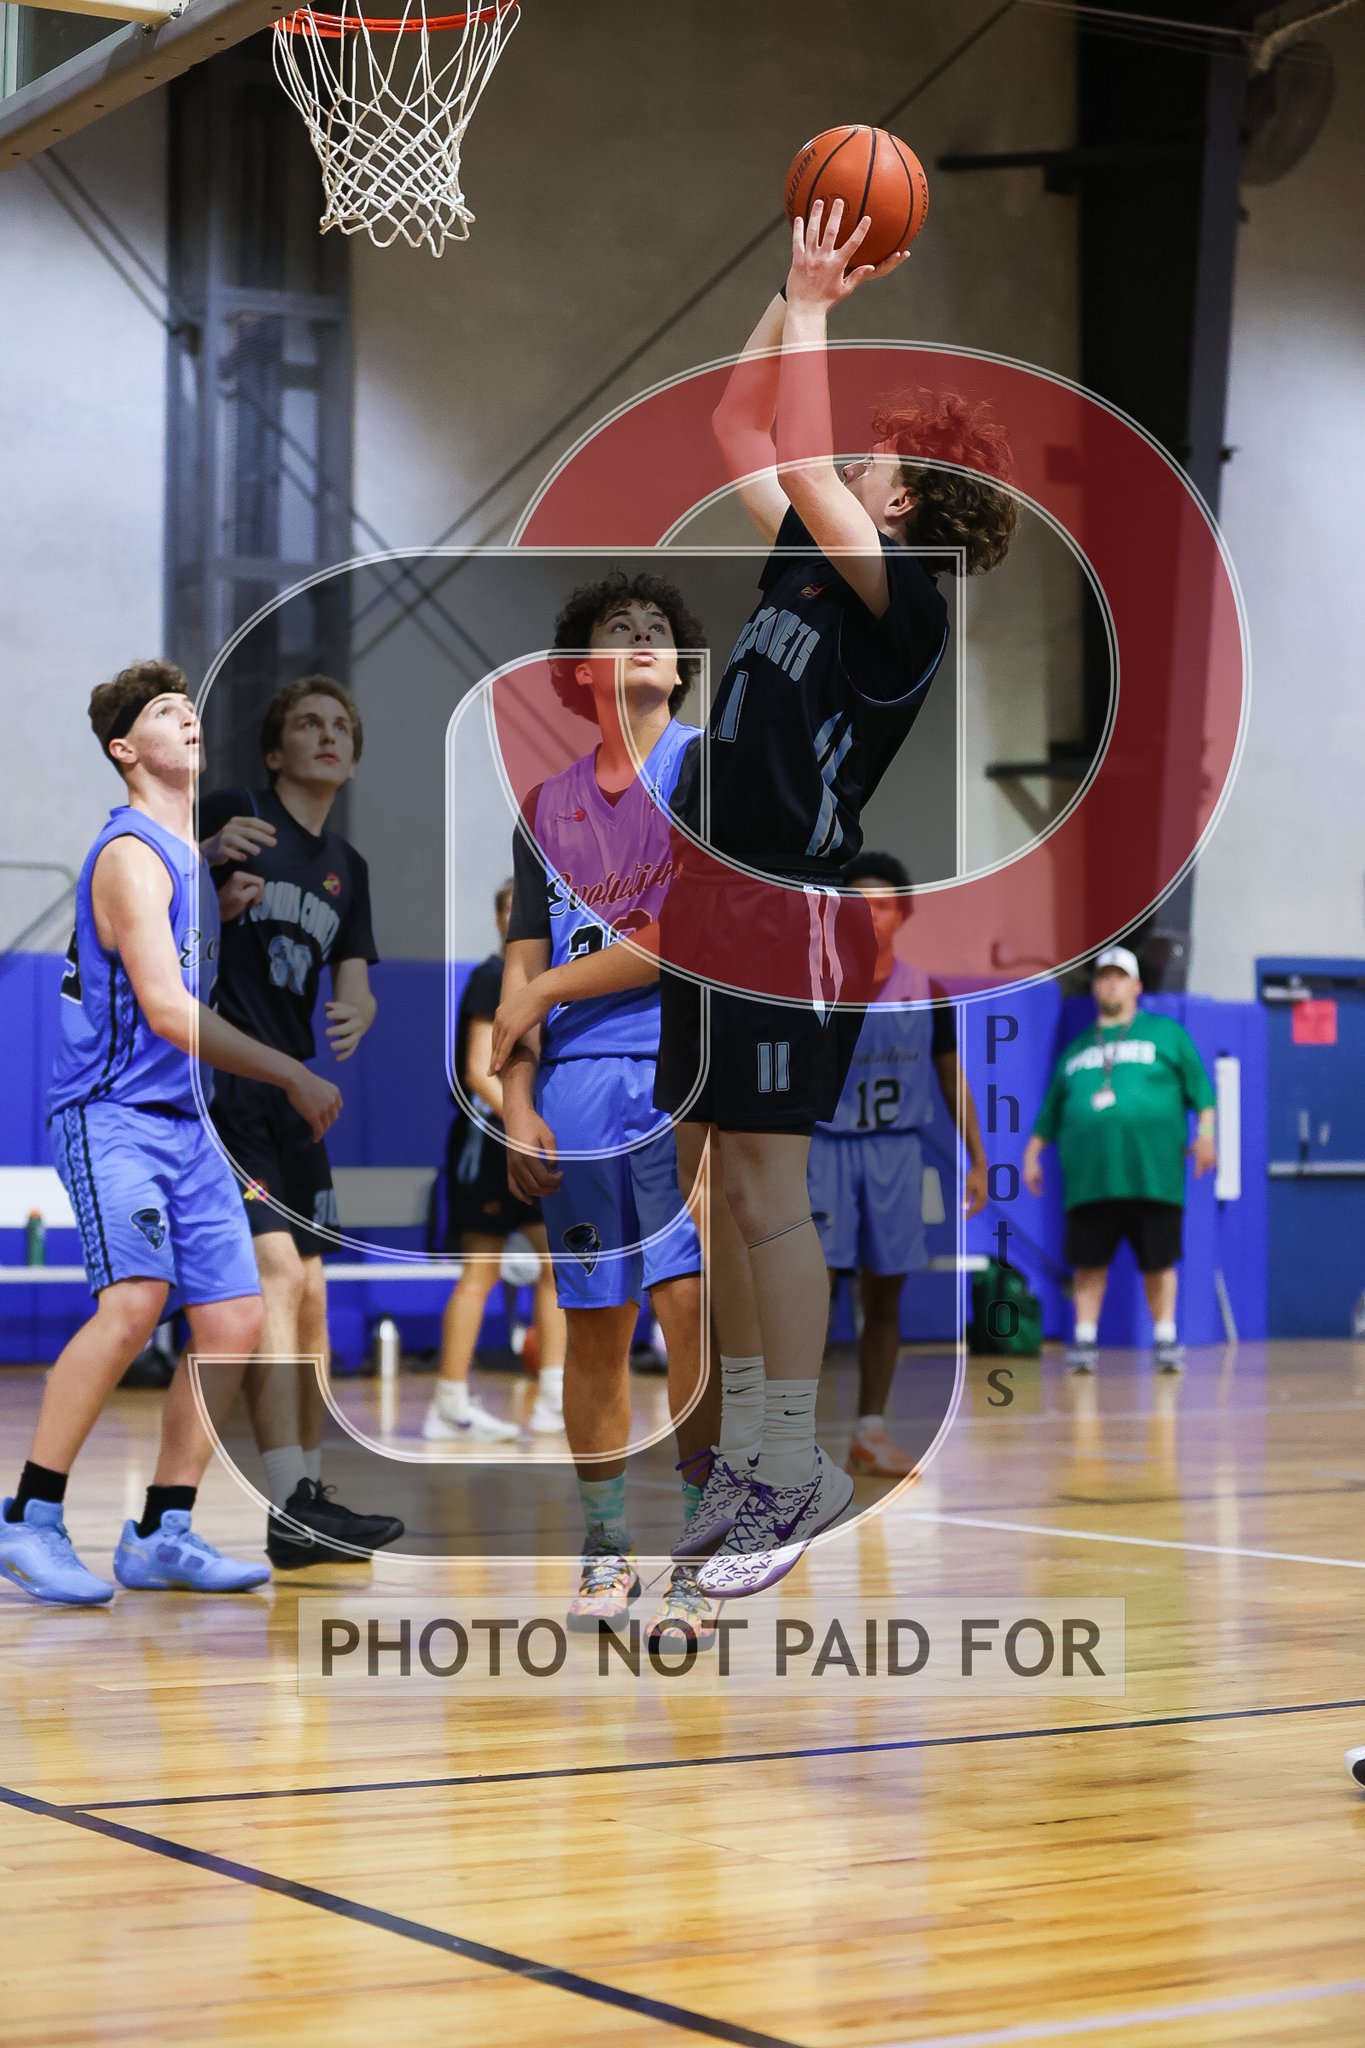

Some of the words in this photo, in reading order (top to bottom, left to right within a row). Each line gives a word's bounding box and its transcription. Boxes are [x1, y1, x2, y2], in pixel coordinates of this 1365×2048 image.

[547, 862, 675, 918] Evolution
[757, 1041, 790, 1094] 11
[855, 1078, 901, 1128] 12
